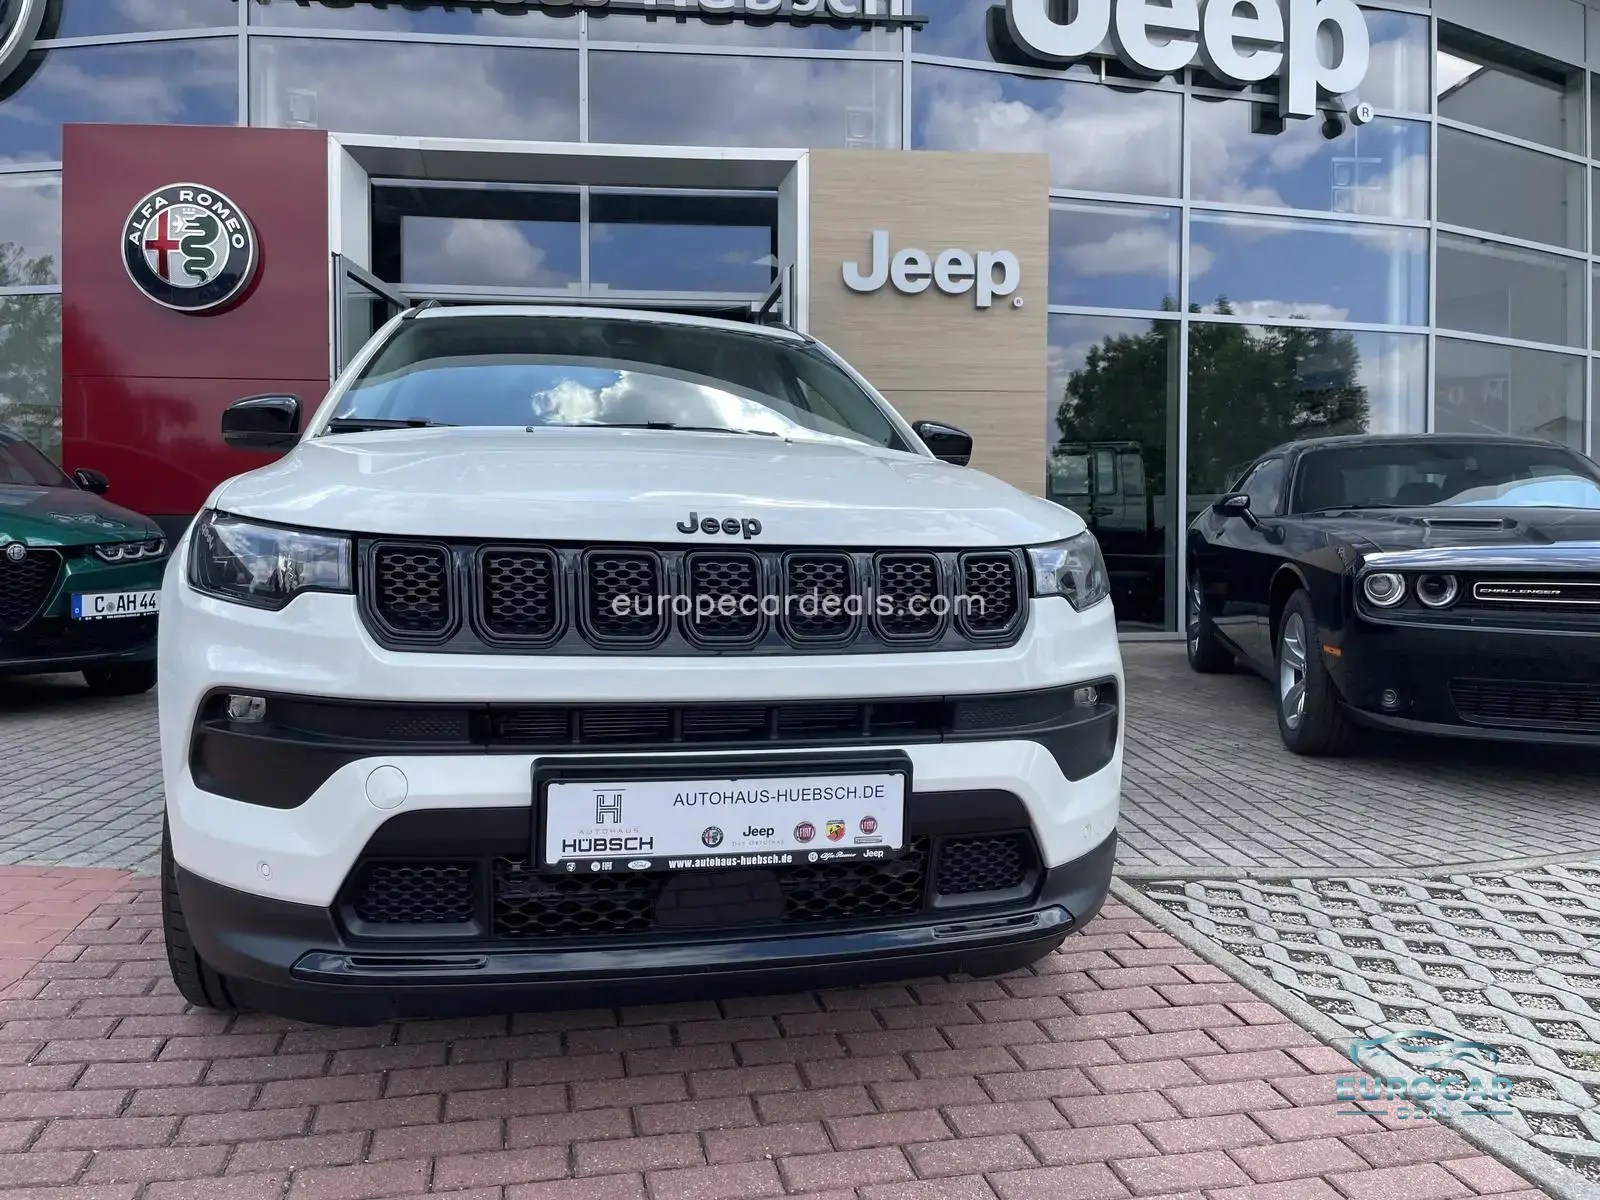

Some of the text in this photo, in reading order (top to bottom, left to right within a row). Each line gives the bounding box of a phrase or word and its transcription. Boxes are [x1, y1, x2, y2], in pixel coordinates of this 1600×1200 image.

[129, 190, 245, 248] ALFA ROMEO
[842, 230, 1020, 307] Jeep
[677, 511, 762, 540] Jeep
[94, 596, 105, 613] C
[673, 784, 885, 806] AUTOHAUS-HUEBSCH.DE
[579, 827, 640, 835] AUTOHAUS
[743, 826, 775, 838] Jeep
[562, 836, 653, 853] HÜBSCH
[669, 854, 793, 869] www.autohaus-huebsch.de
[863, 849, 884, 858] Jeep
